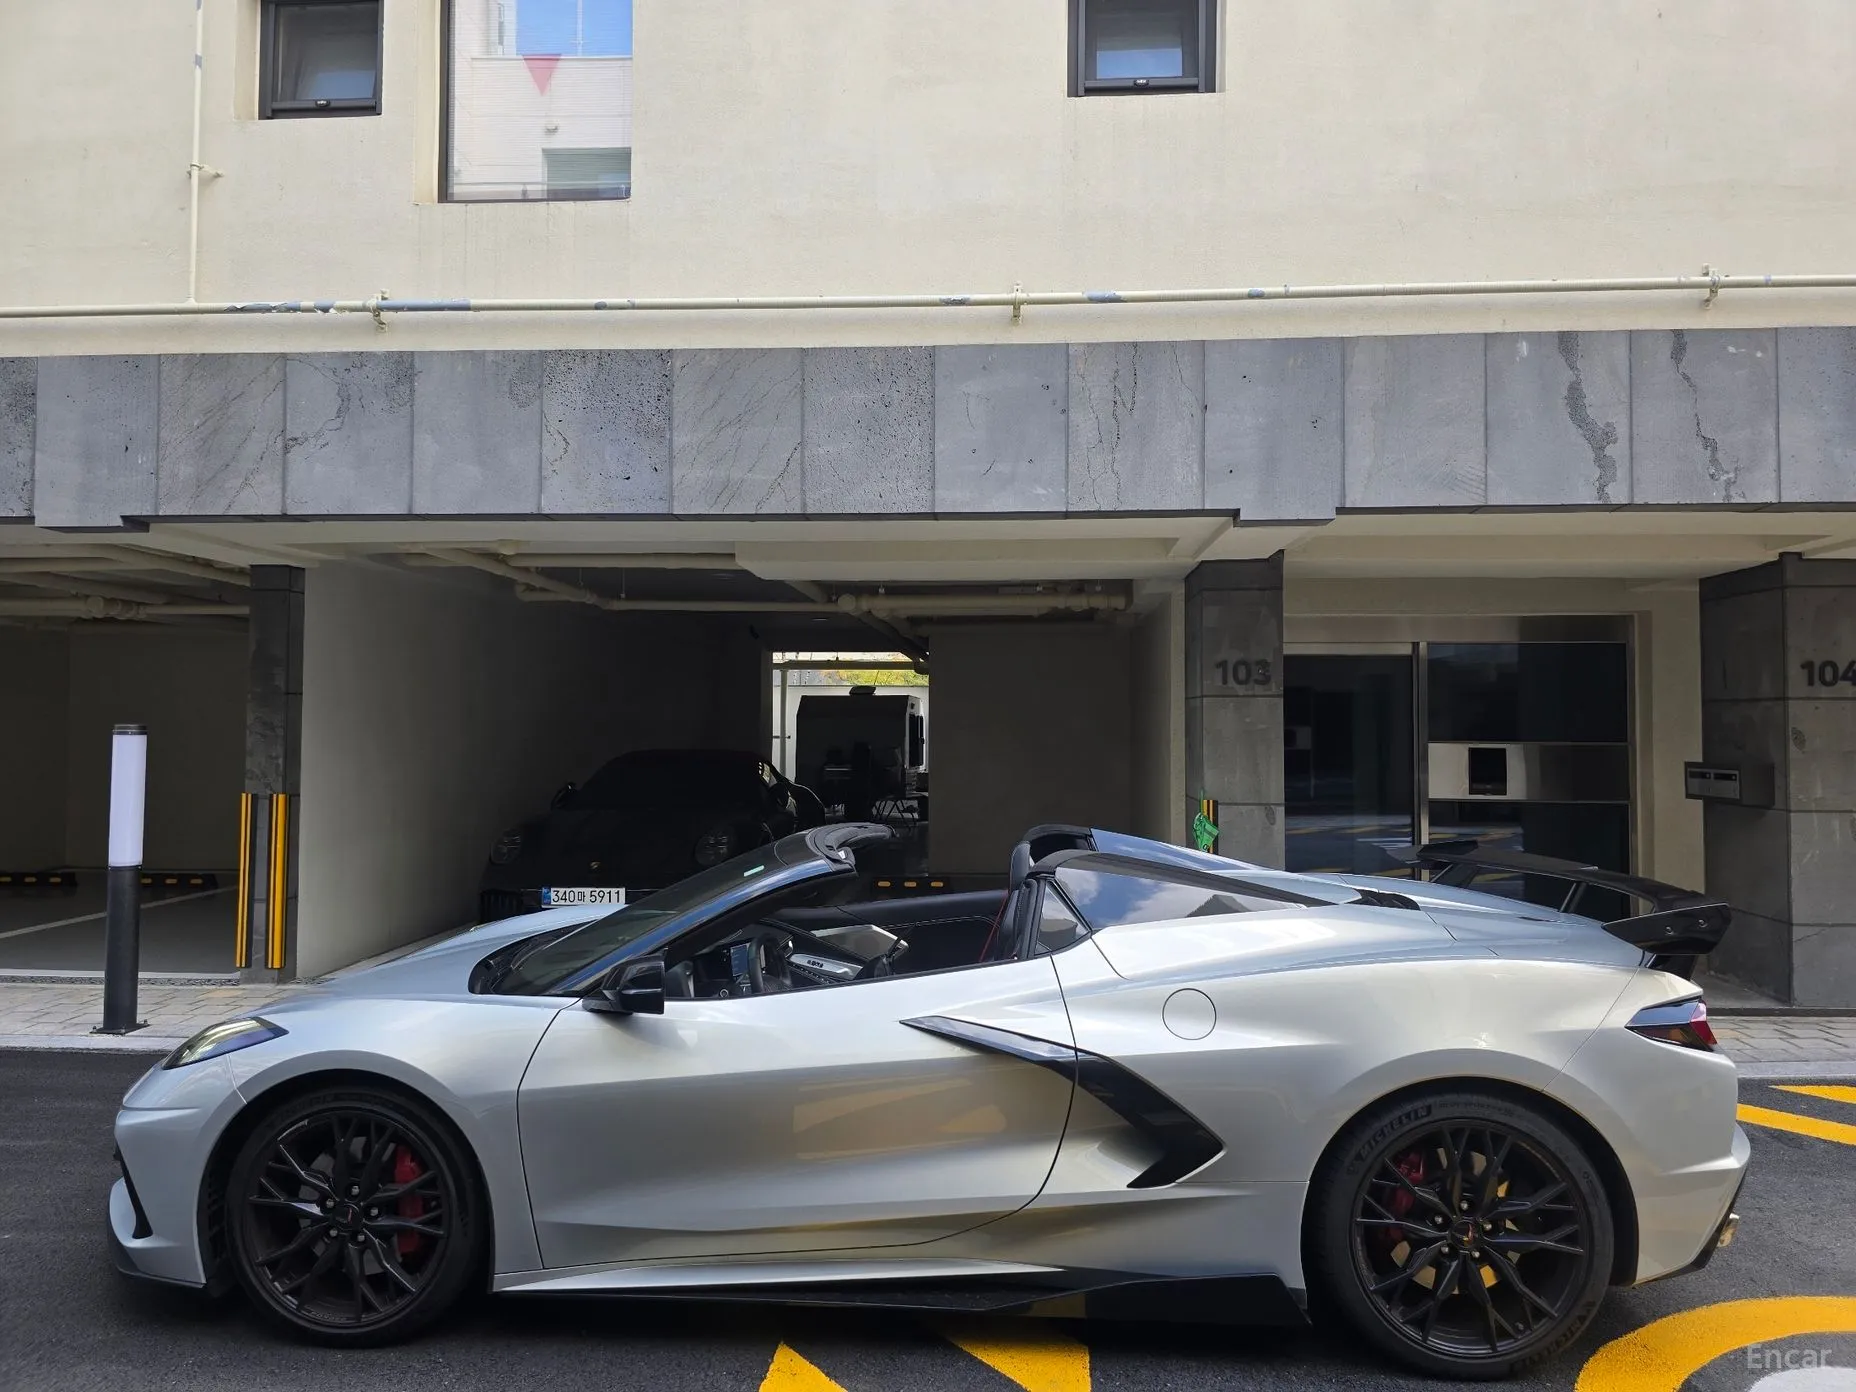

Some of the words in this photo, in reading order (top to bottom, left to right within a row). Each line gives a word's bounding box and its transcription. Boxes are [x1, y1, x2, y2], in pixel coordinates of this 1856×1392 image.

[1215, 659, 1272, 686] 103
[1799, 659, 1856, 687] 104
[552, 889, 586, 903] 340마
[589, 889, 620, 903] 5911
[1358, 1104, 1432, 1162] MICHELIN
